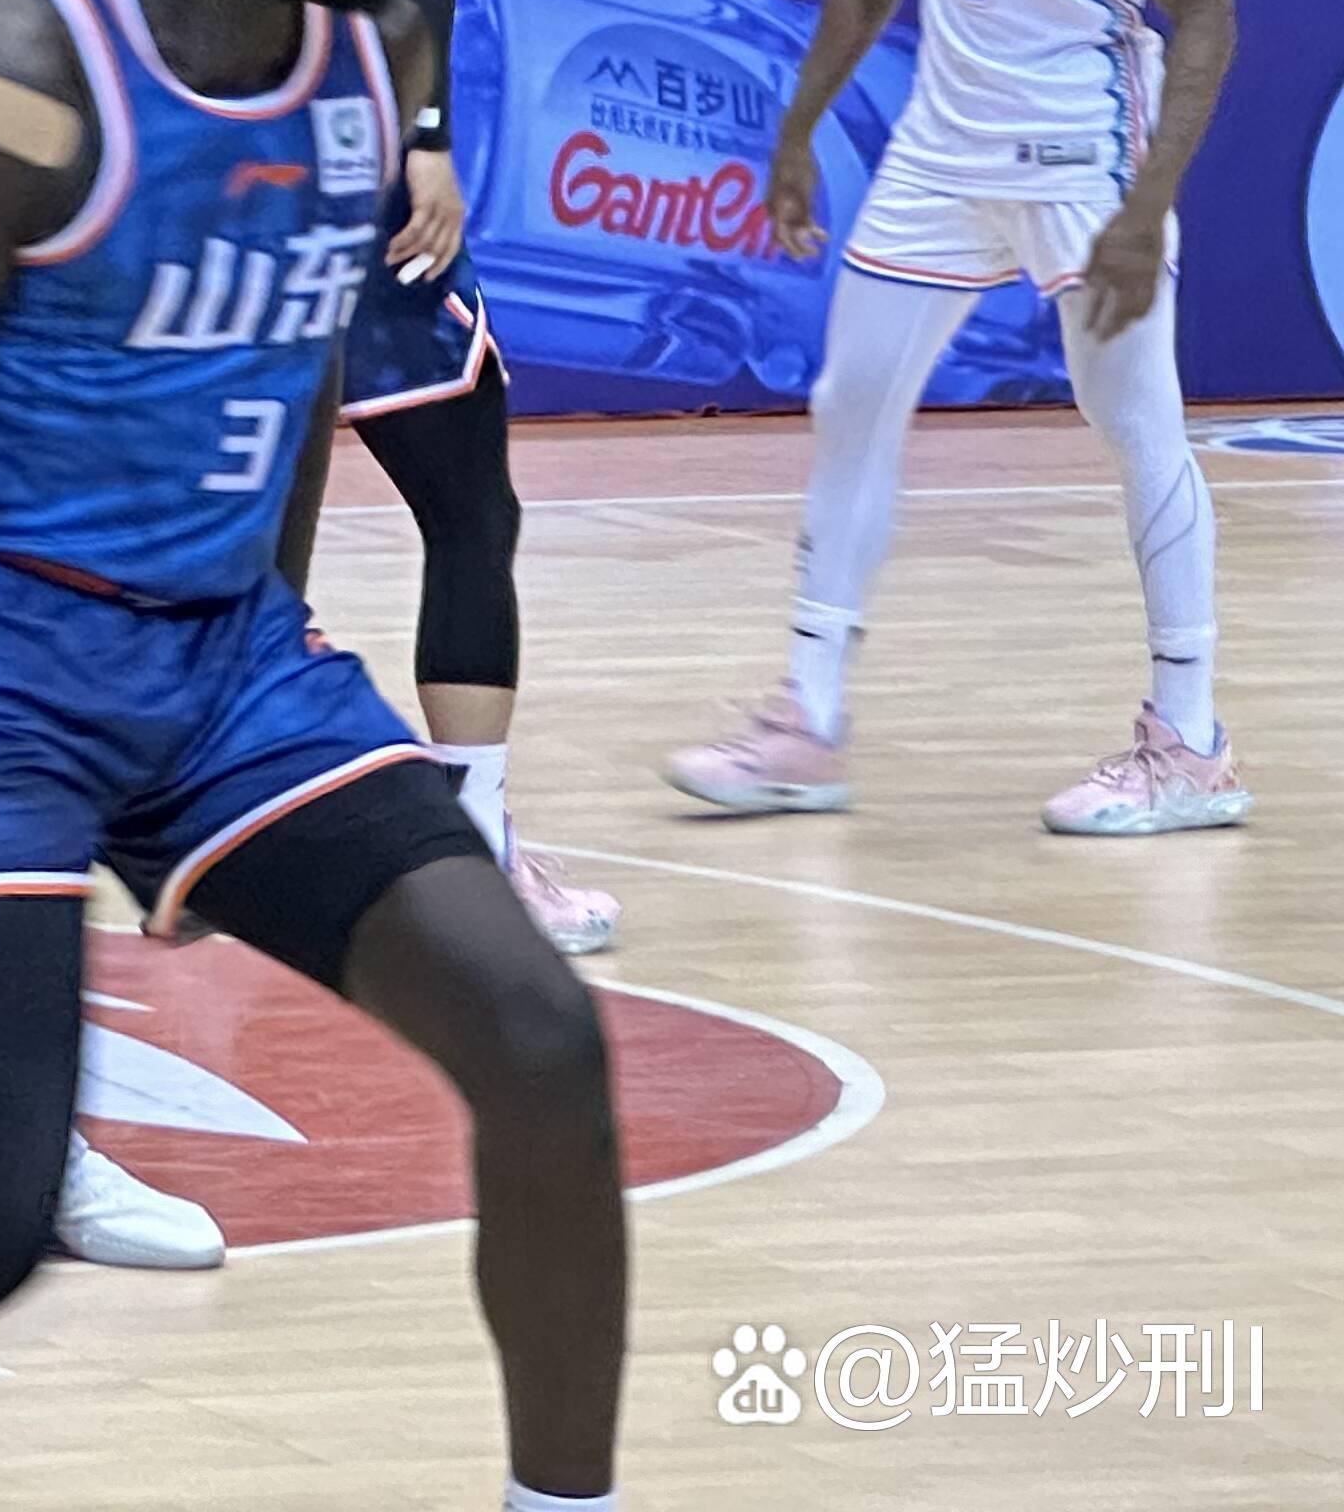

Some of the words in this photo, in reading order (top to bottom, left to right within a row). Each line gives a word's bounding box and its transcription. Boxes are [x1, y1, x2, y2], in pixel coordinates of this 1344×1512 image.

[655, 56, 765, 131] 百岁山
[125, 224, 377, 350] 山东
[198, 398, 287, 494] 3
